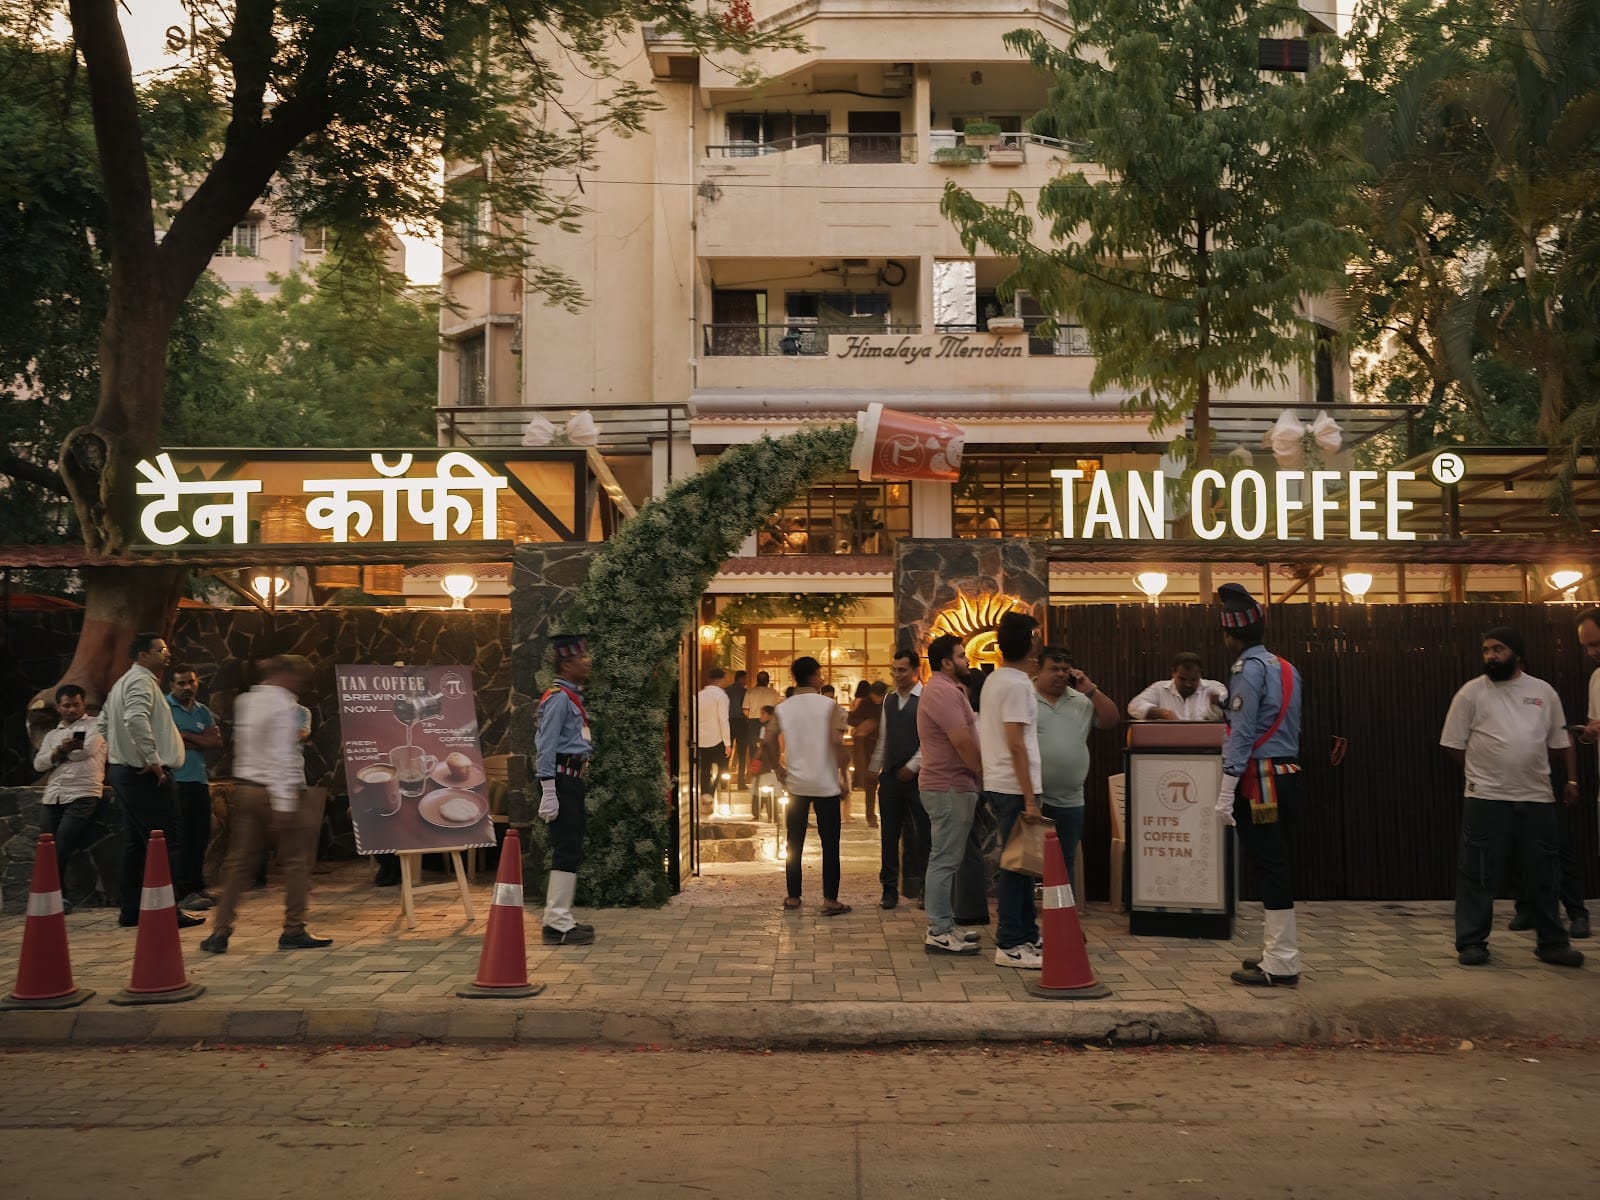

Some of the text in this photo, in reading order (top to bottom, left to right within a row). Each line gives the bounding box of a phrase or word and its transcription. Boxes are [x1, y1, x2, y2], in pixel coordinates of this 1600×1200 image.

[837, 335, 1023, 365] Himalaya Meridian
[135, 451, 508, 546] टैन कॉफी
[1050, 469, 1165, 540] TAN
[1191, 469, 1416, 541] COFFEE
[339, 676, 425, 691] TAN COFFEE
[343, 693, 407, 701] BREWING
[343, 705, 378, 713] NOW
[1143, 816, 1179, 827] IF IT'S
[1143, 831, 1191, 842] COFFEE
[1143, 846, 1192, 858] IT'S TAN
